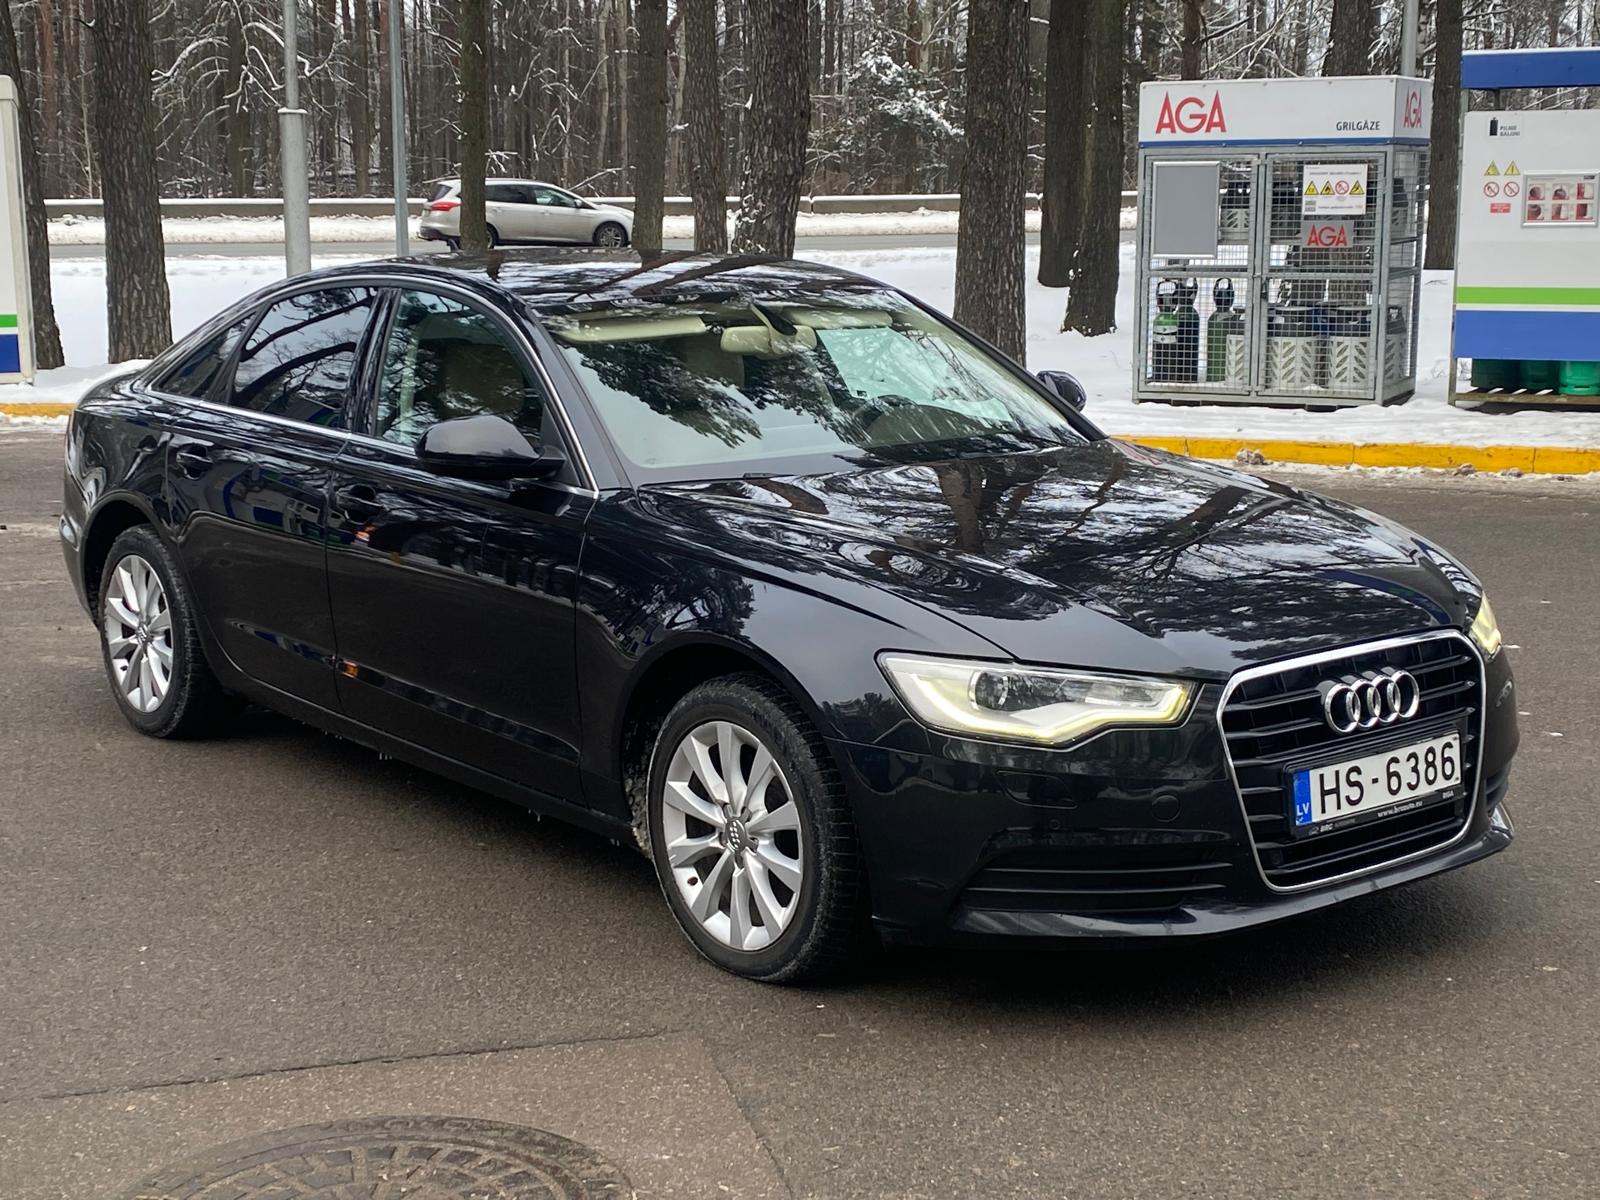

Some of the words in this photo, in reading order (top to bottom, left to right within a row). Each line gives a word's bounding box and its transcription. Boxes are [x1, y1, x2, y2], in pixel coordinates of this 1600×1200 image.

[1155, 90, 1227, 134] AGA
[1403, 86, 1422, 129] AGA
[1336, 120, 1381, 132] GRILGĀZE
[1307, 224, 1349, 248] AGA
[1318, 741, 1456, 815] HS-6386
[1296, 802, 1310, 816] LV
